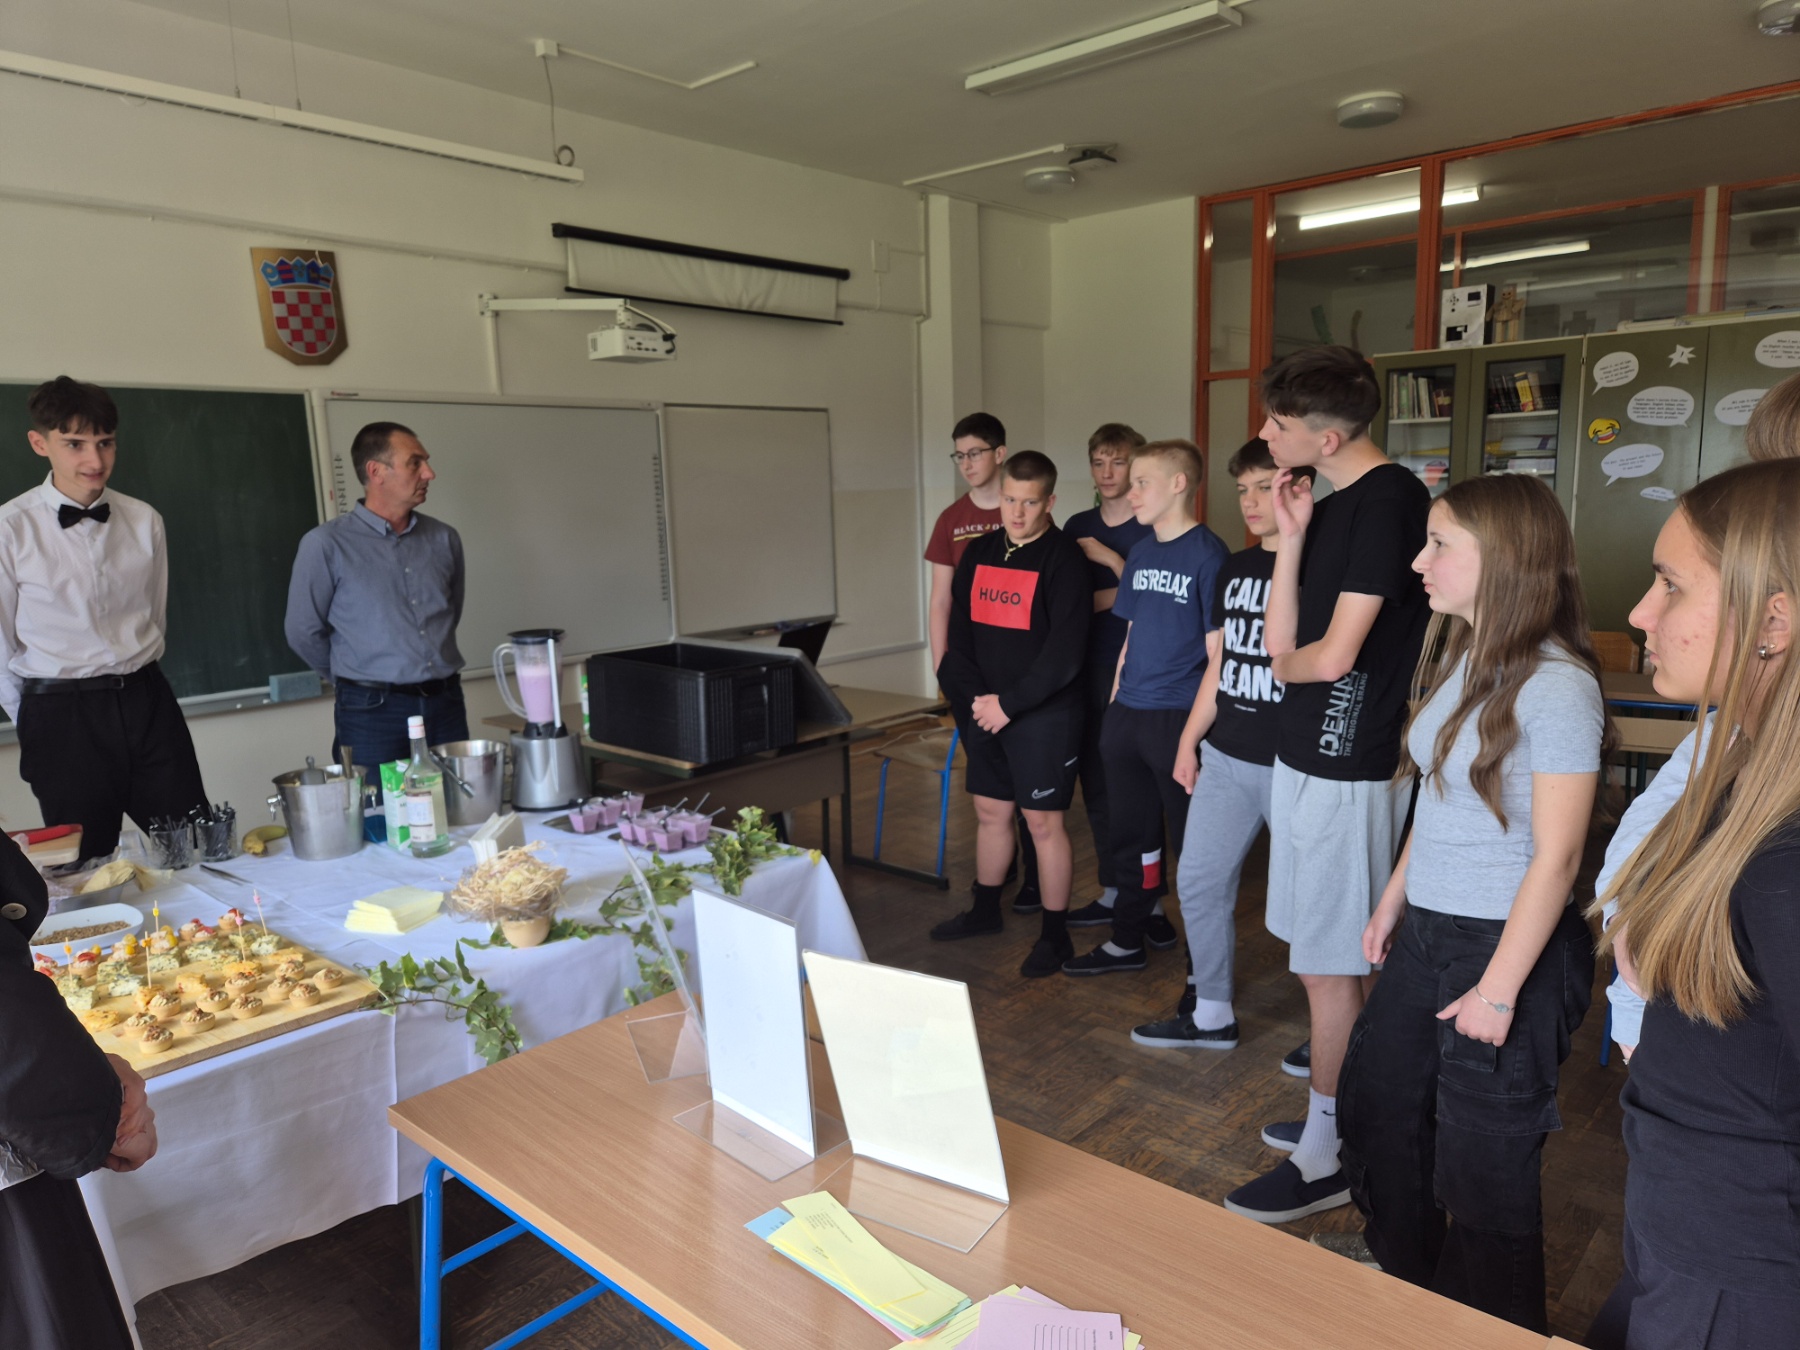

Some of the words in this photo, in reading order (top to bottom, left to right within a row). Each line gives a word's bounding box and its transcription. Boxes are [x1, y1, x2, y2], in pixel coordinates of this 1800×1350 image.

[953, 524, 984, 535] BLACK
[979, 586, 1022, 606] HUGO
[1224, 577, 1272, 613] CAL
[1218, 658, 1286, 703] JEANS
[1356, 672, 1368, 701] BRAND
[1319, 670, 1359, 757] DENIM
[1347, 702, 1363, 740] ORIGINAL
[1343, 741, 1353, 757] THE
